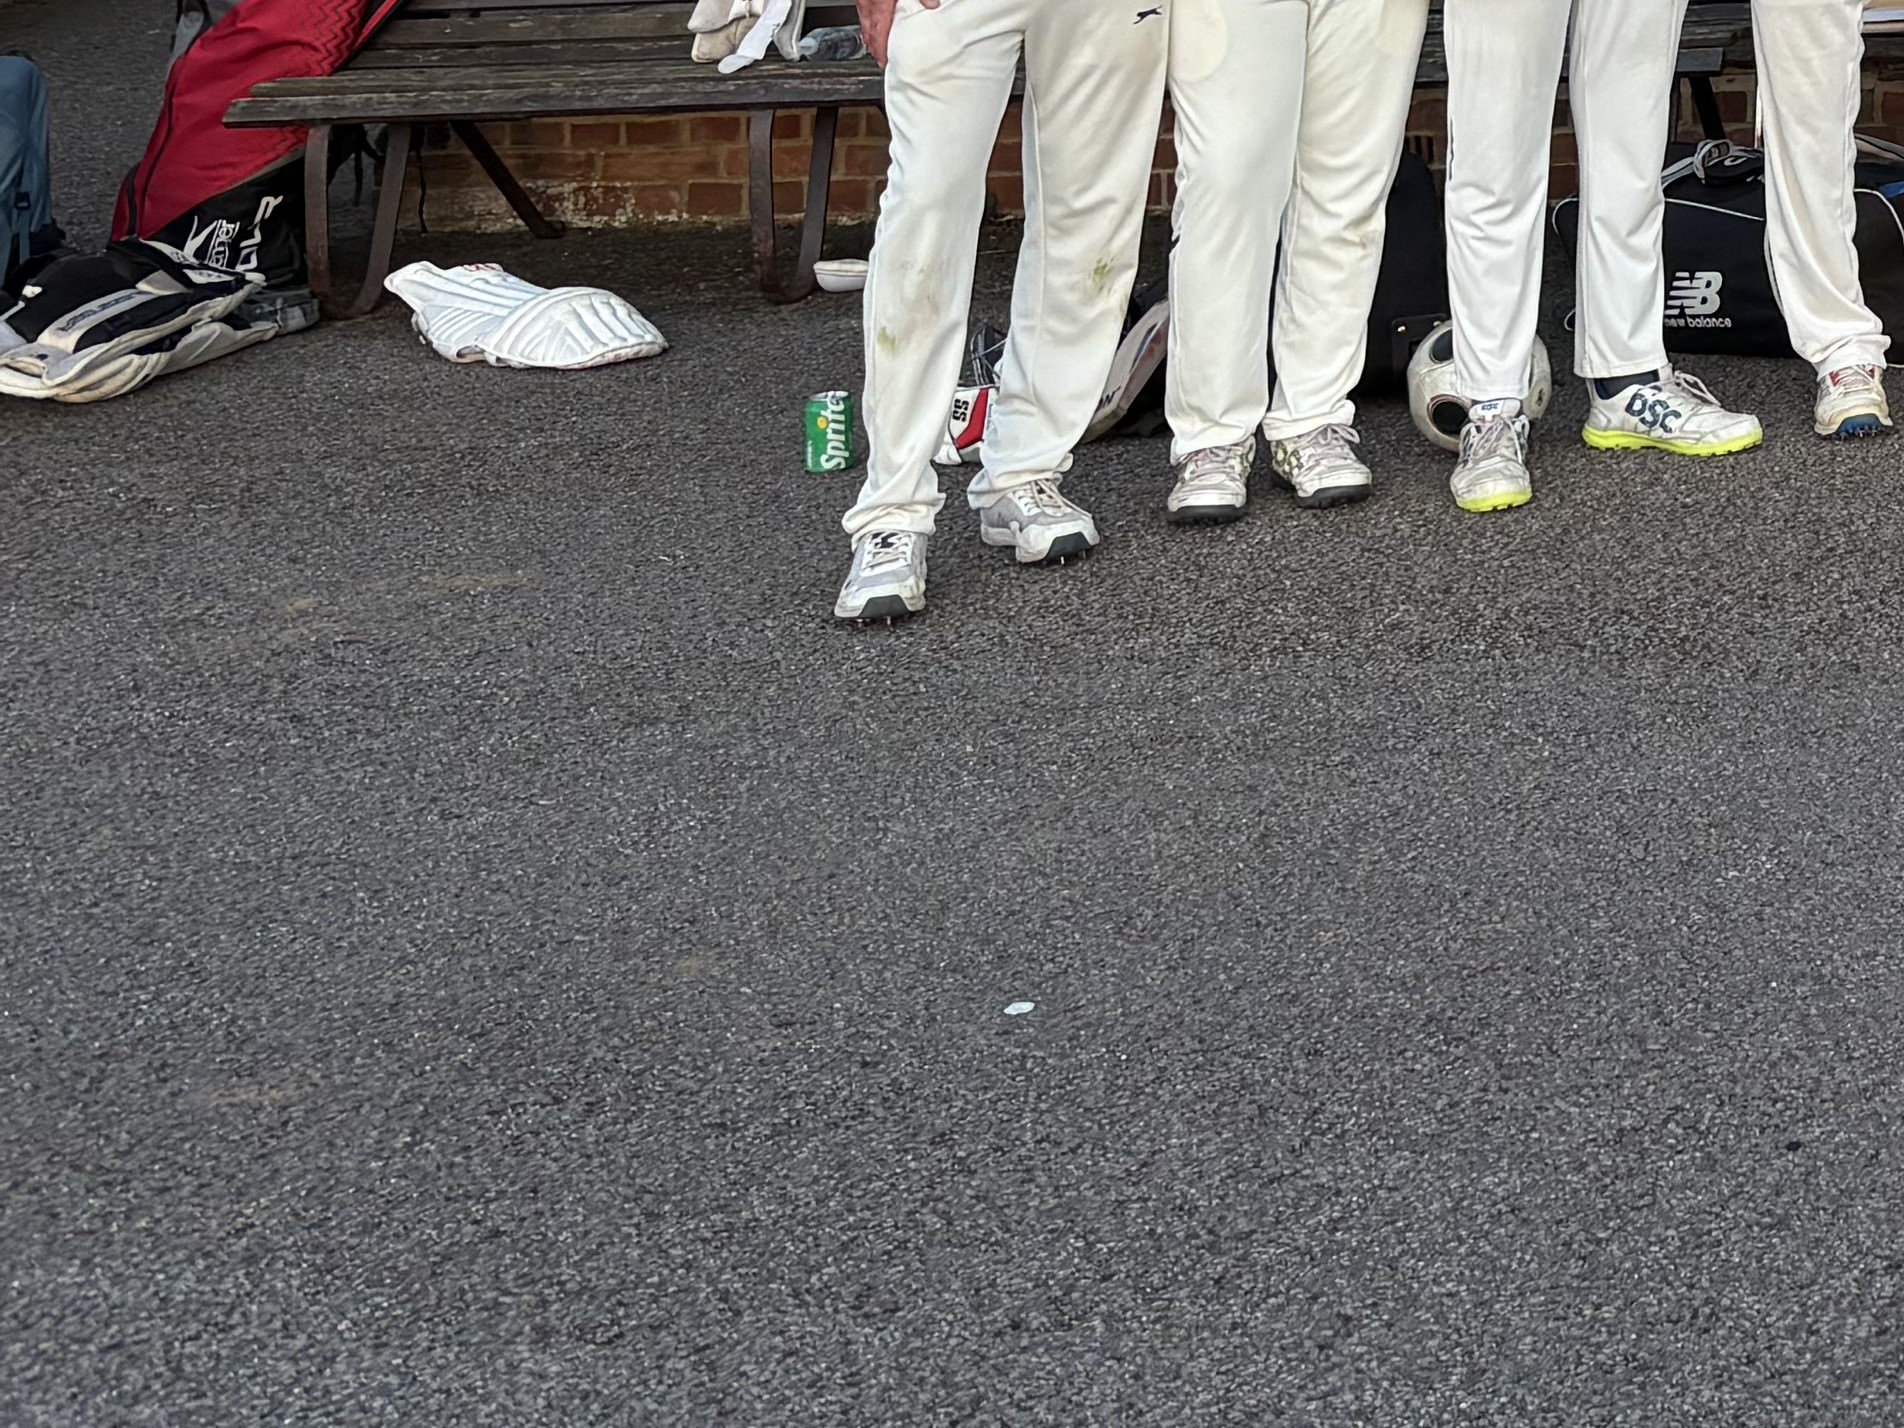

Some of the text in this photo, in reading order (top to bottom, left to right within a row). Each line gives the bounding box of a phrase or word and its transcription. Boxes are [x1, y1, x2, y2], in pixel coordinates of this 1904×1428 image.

[1688, 316, 1732, 328] balance
[820, 392, 850, 471] Sprite
[1624, 391, 1682, 434] DSC
